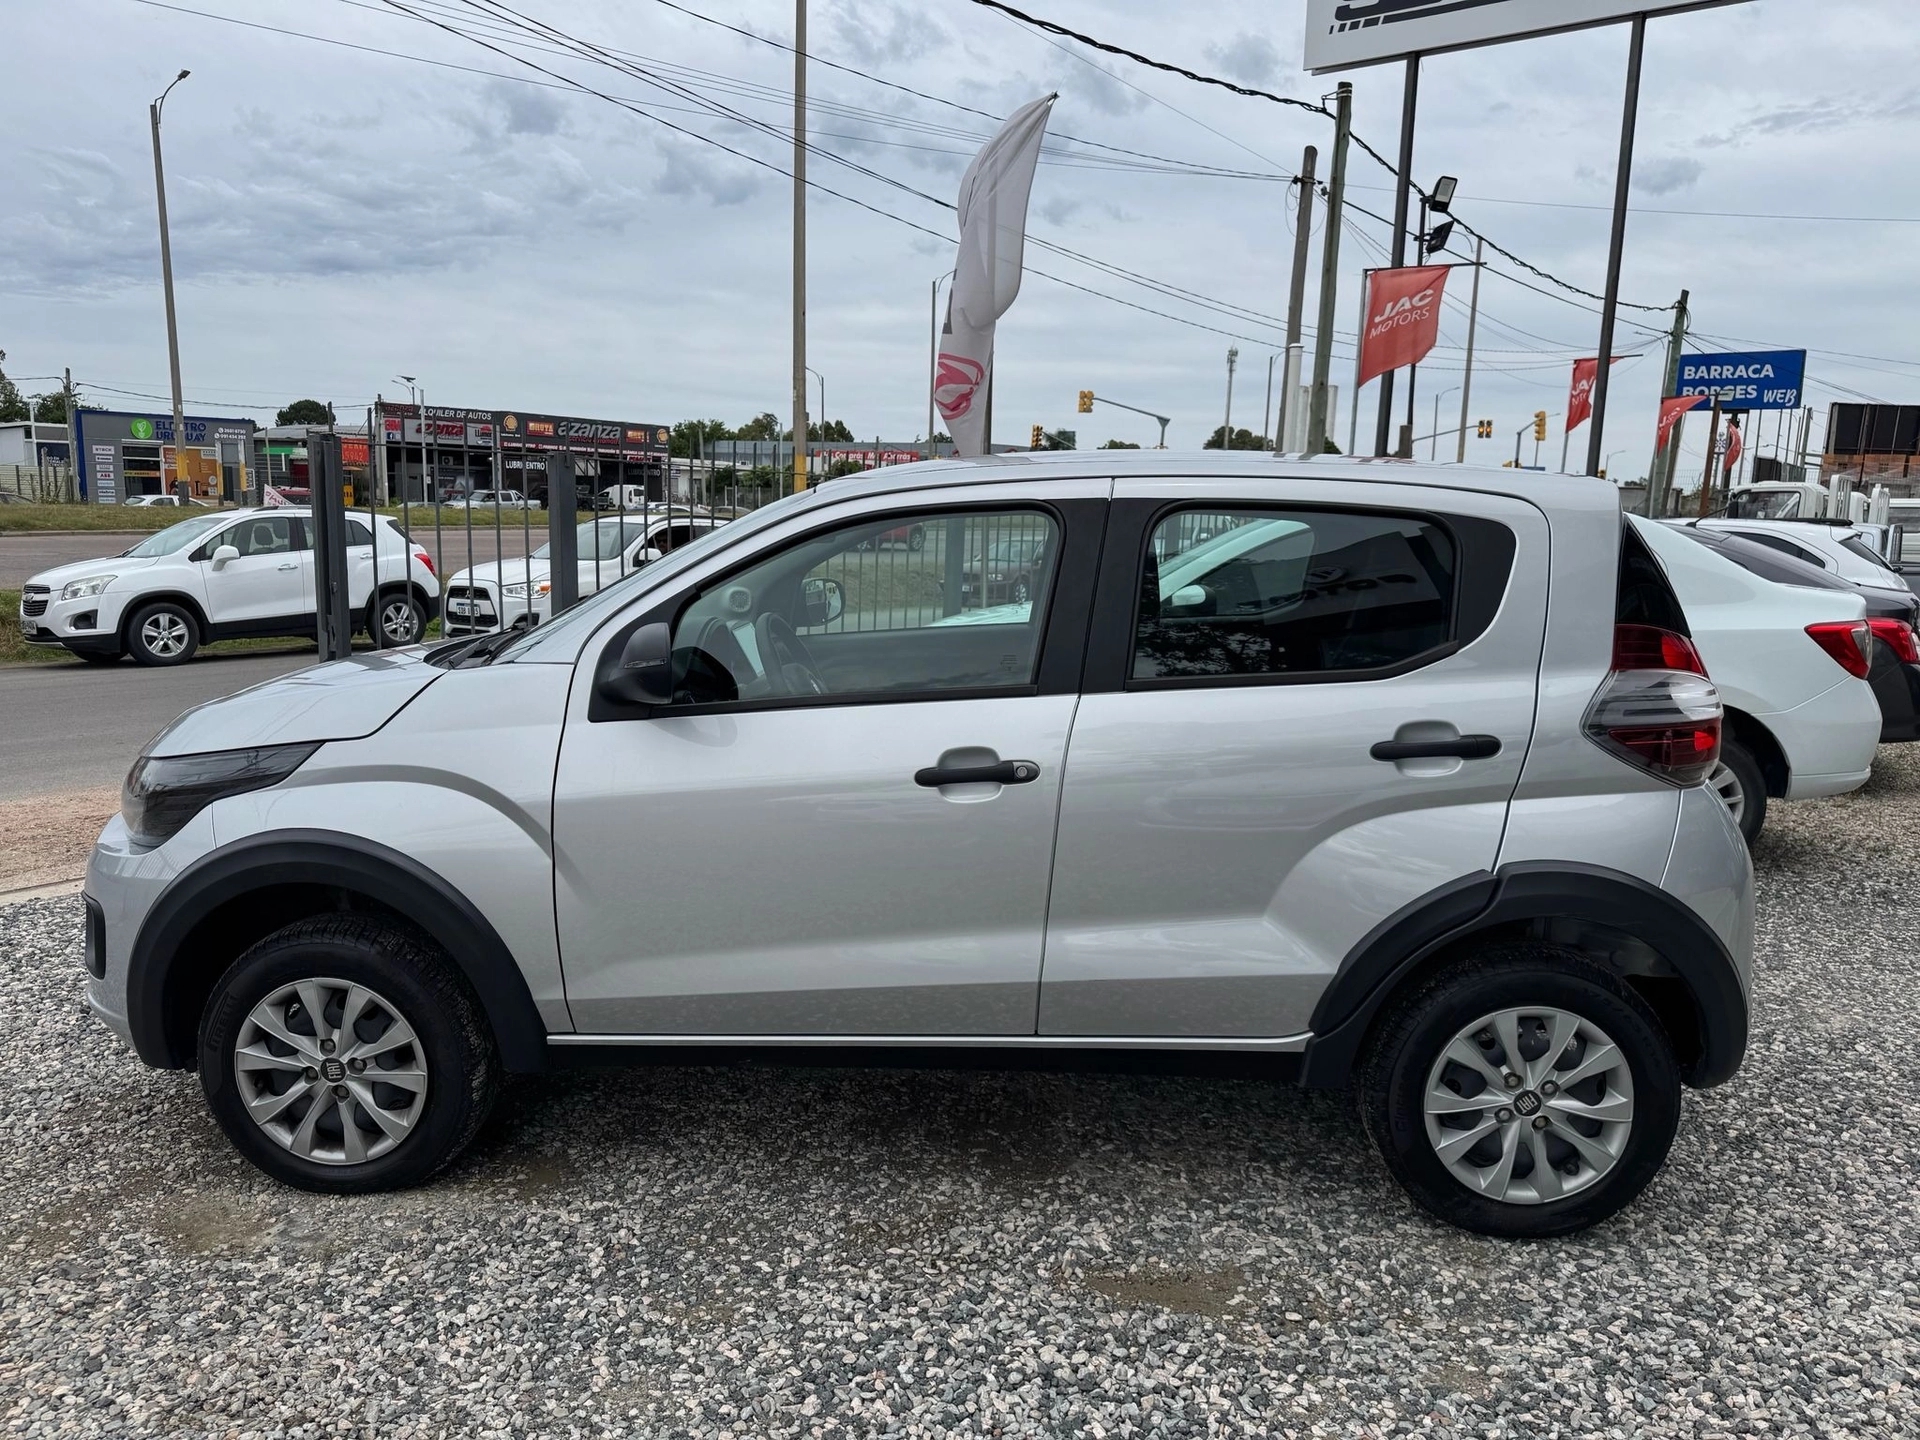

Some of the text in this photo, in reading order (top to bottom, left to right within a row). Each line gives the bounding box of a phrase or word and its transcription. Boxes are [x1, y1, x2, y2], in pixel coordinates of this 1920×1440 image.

[1374, 289, 1434, 323] JAC
[1369, 306, 1430, 339] MOTORS
[1683, 364, 1775, 380] BARRACA
[456, 410, 466, 418] DE
[468, 411, 492, 420] AUTOS
[155, 420, 207, 432] ELETRO
[557, 421, 621, 439] azanza
[156, 431, 206, 442] URUUAY
[505, 460, 545, 470] LUBRIENTRO
[326, 1062, 343, 1079] FIAT
[1516, 1093, 1539, 1114] FIAT
